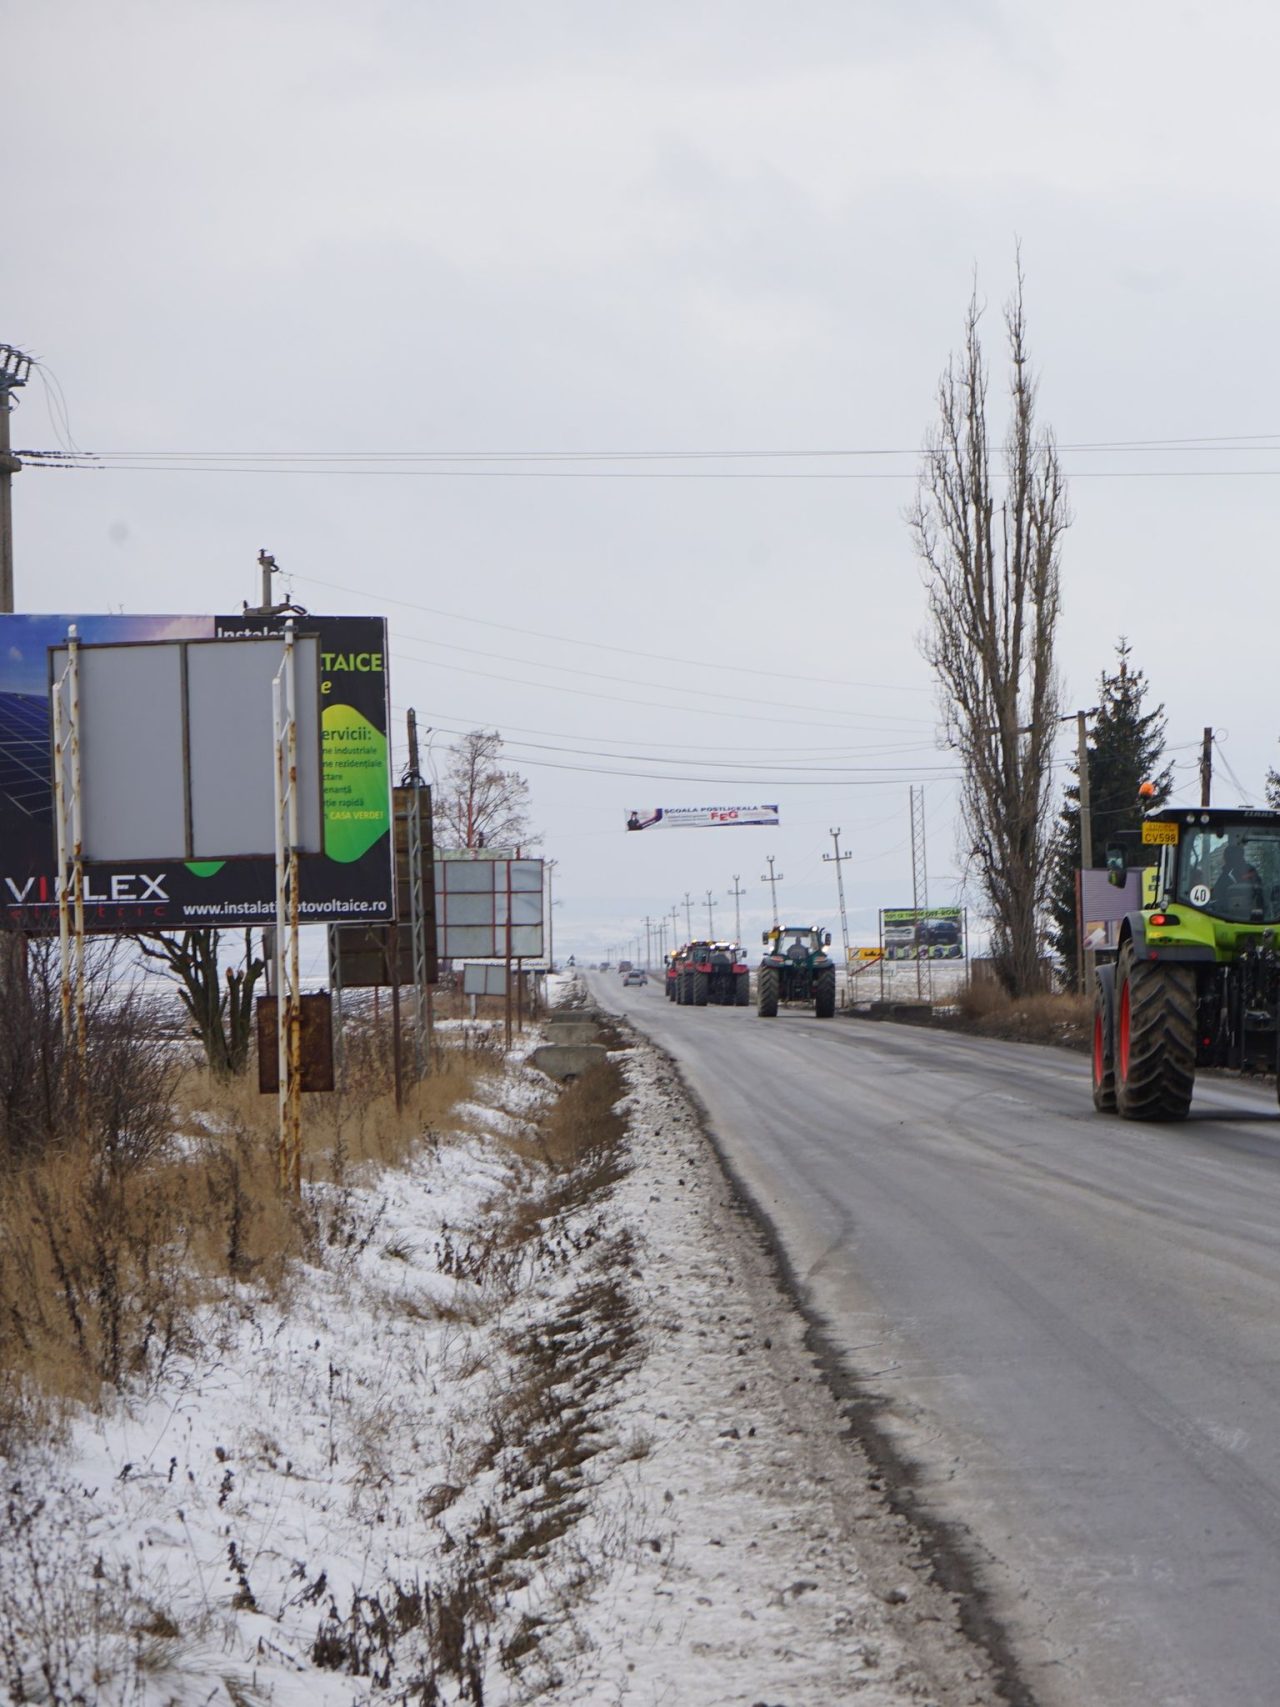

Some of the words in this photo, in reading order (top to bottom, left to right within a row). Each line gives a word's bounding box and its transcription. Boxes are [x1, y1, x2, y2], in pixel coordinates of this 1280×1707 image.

[320, 653, 383, 671] TAICE
[710, 811, 738, 822] FEG
[1145, 833, 1176, 843] CV598
[1194, 889, 1206, 902] 40
